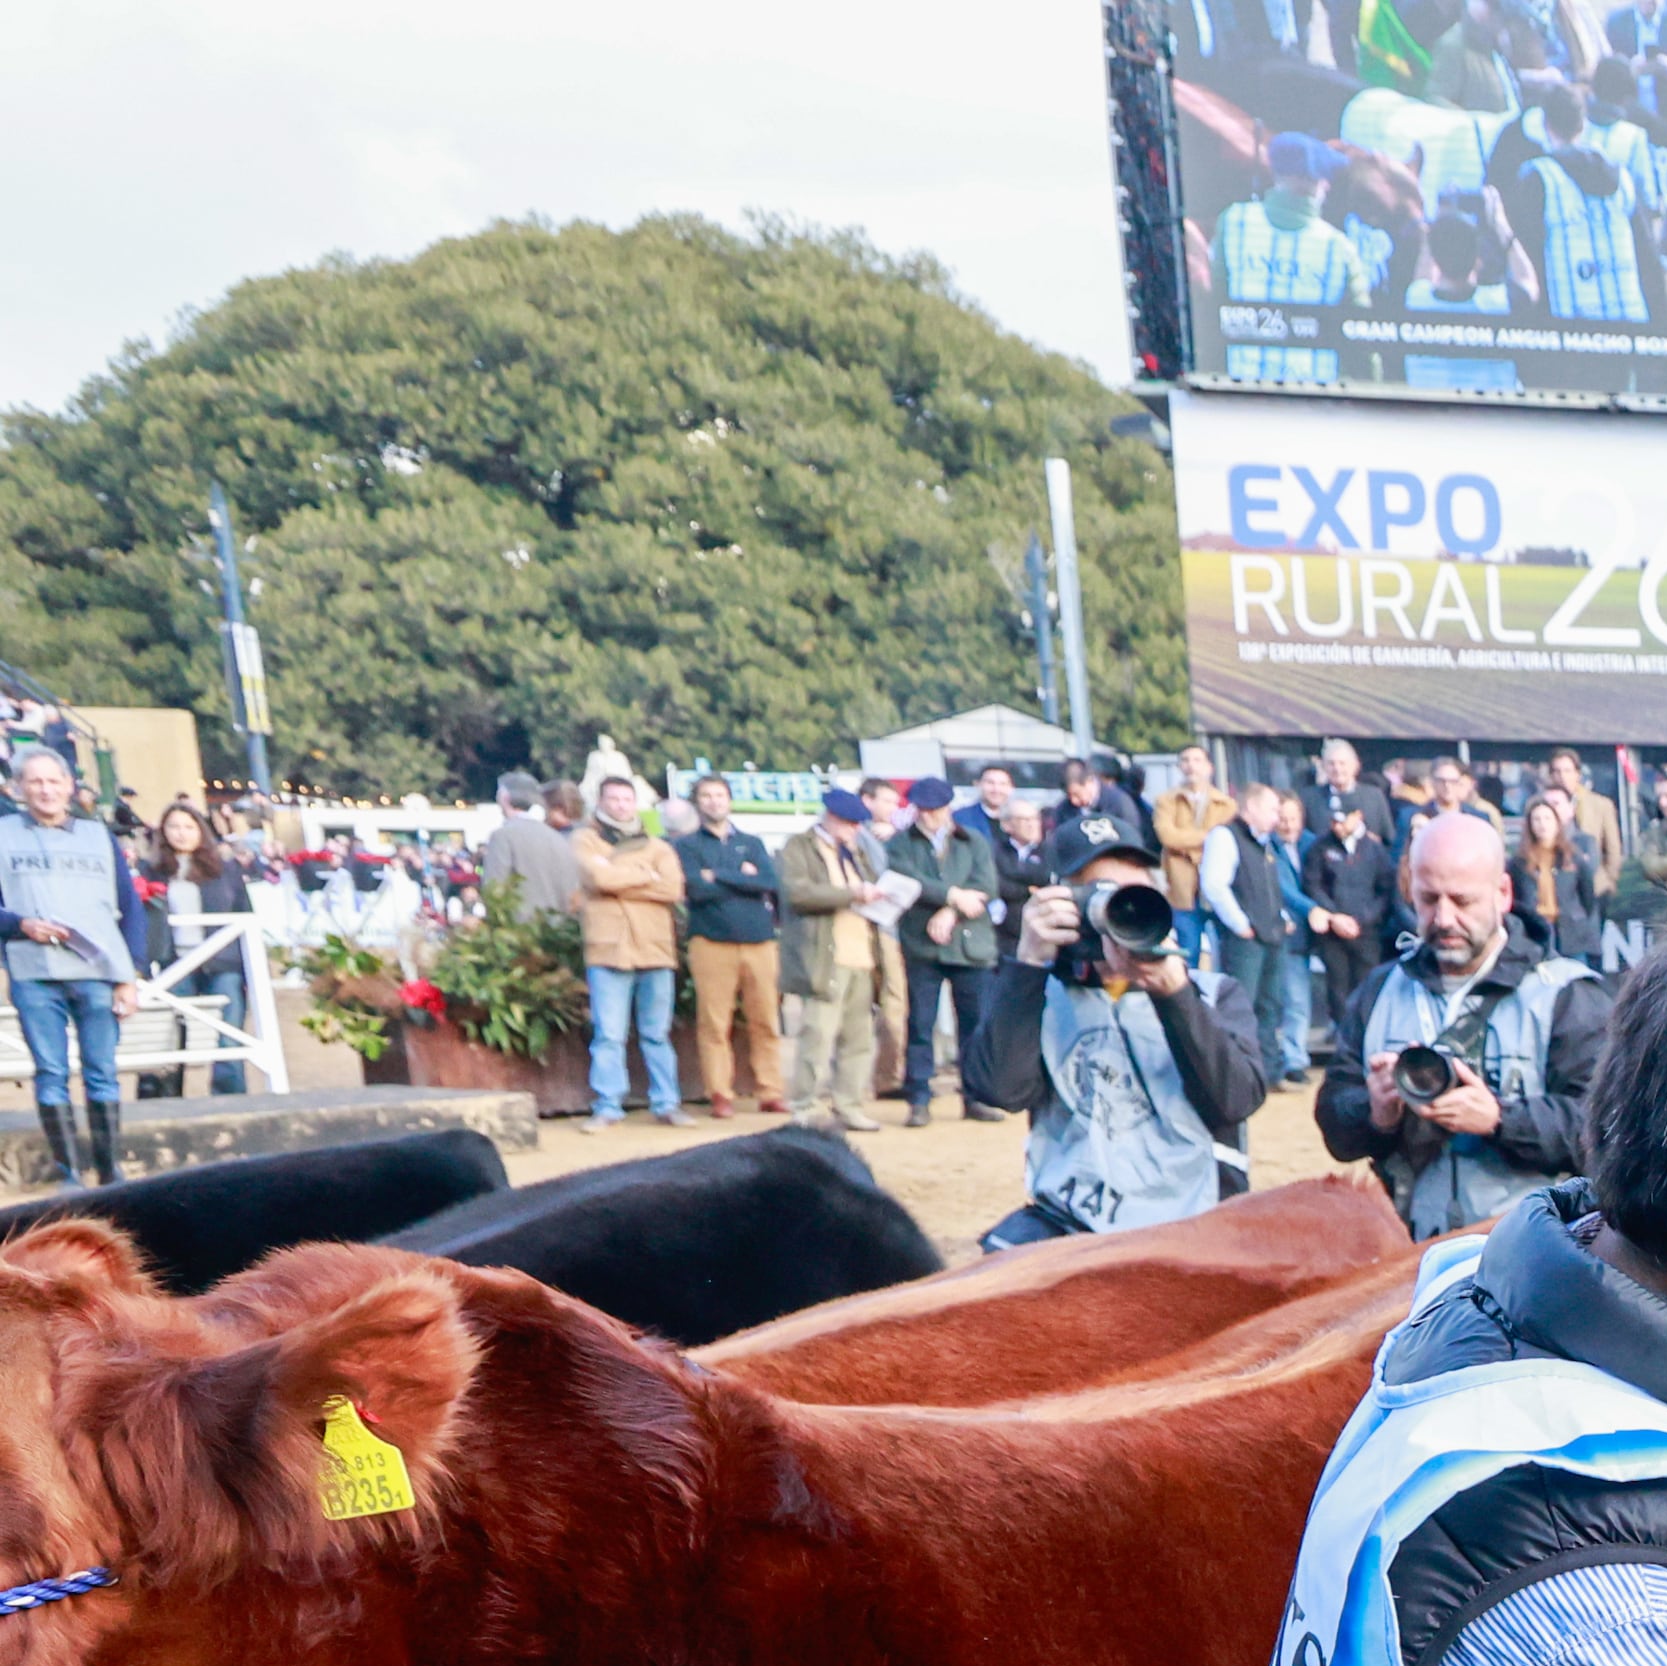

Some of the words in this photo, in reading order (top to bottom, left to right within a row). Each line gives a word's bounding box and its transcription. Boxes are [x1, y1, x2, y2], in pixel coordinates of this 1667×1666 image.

[1562, 331, 1632, 354] MACHO
[1227, 463, 1502, 557] EXPO
[1229, 553, 1536, 644] RURAL
[1352, 644, 1371, 666] DE
[1057, 1176, 1125, 1225] 147
[355, 1452, 385, 1471] 813
